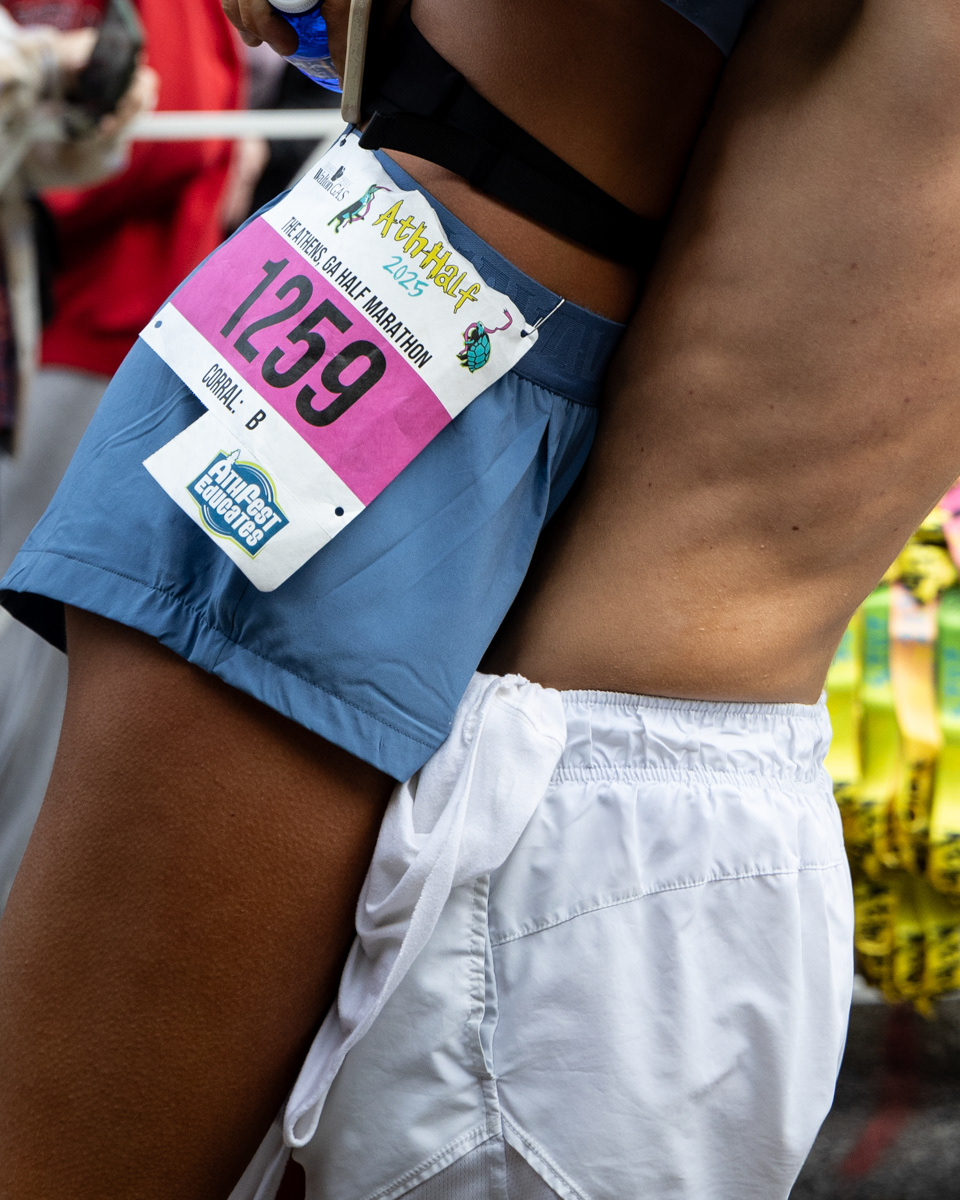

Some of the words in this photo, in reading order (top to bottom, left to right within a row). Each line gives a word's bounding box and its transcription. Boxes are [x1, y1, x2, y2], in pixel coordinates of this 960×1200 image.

[281, 216, 301, 237] THE
[292, 228, 327, 267] ATHENS,
[321, 256, 342, 277] GA
[335, 268, 371, 300] HALF
[362, 296, 432, 369] MARATHON
[372, 200, 481, 314] AthHalf
[382, 256, 429, 297] 2025
[202, 363, 244, 414] CORRAL:
[245, 409, 267, 430] B
[220, 258, 386, 427] 1259
